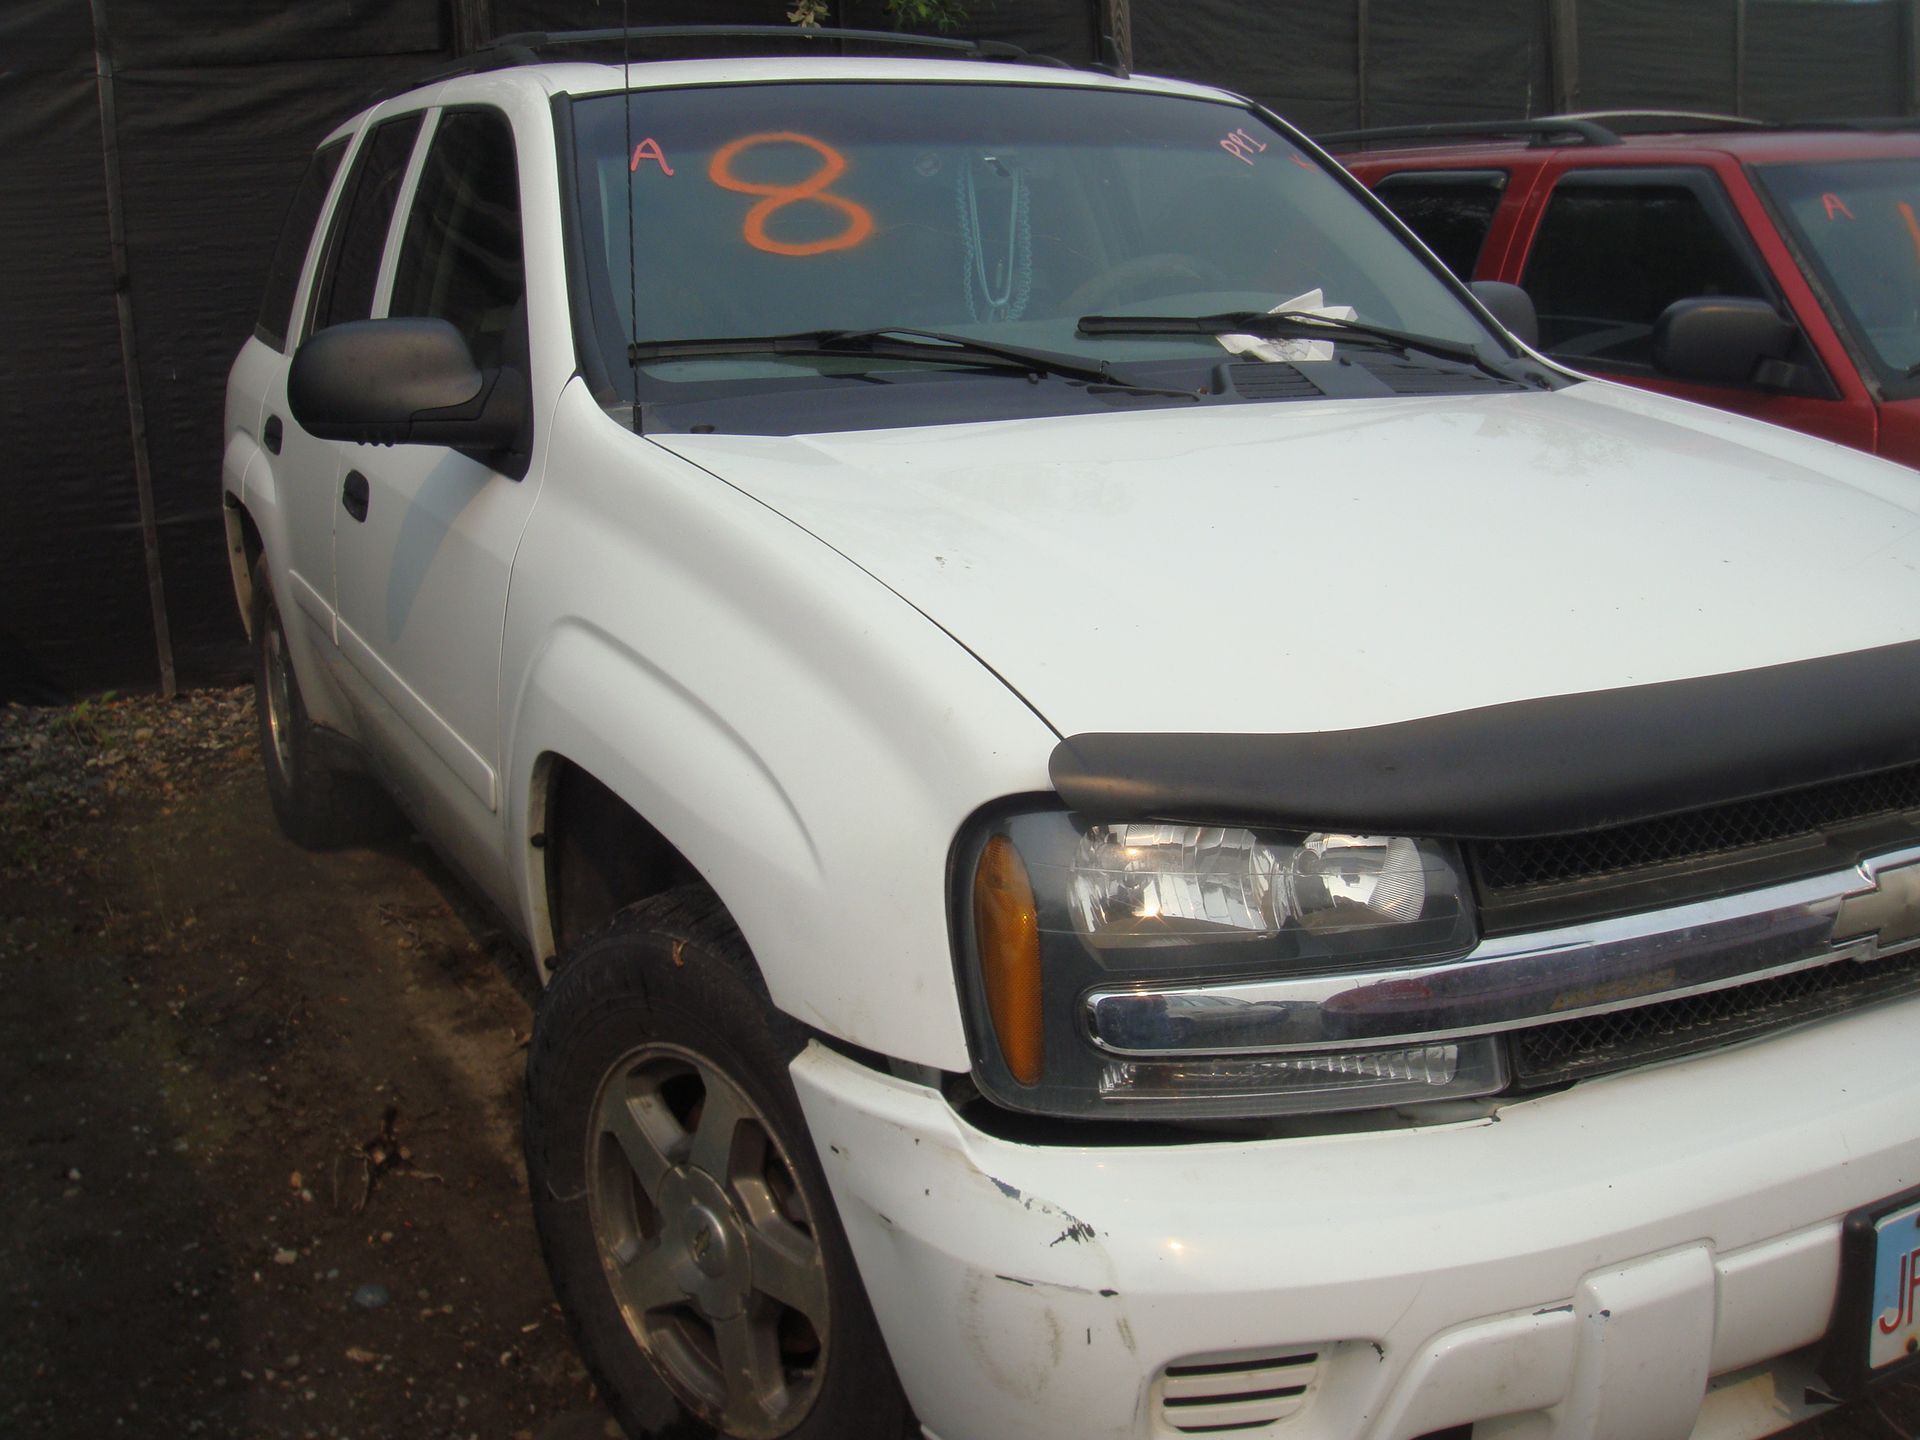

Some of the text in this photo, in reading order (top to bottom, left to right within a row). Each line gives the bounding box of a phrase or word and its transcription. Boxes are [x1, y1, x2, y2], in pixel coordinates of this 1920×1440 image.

[630, 138, 674, 176] A
[708, 131, 874, 256] 8
[1822, 192, 1855, 221] A
